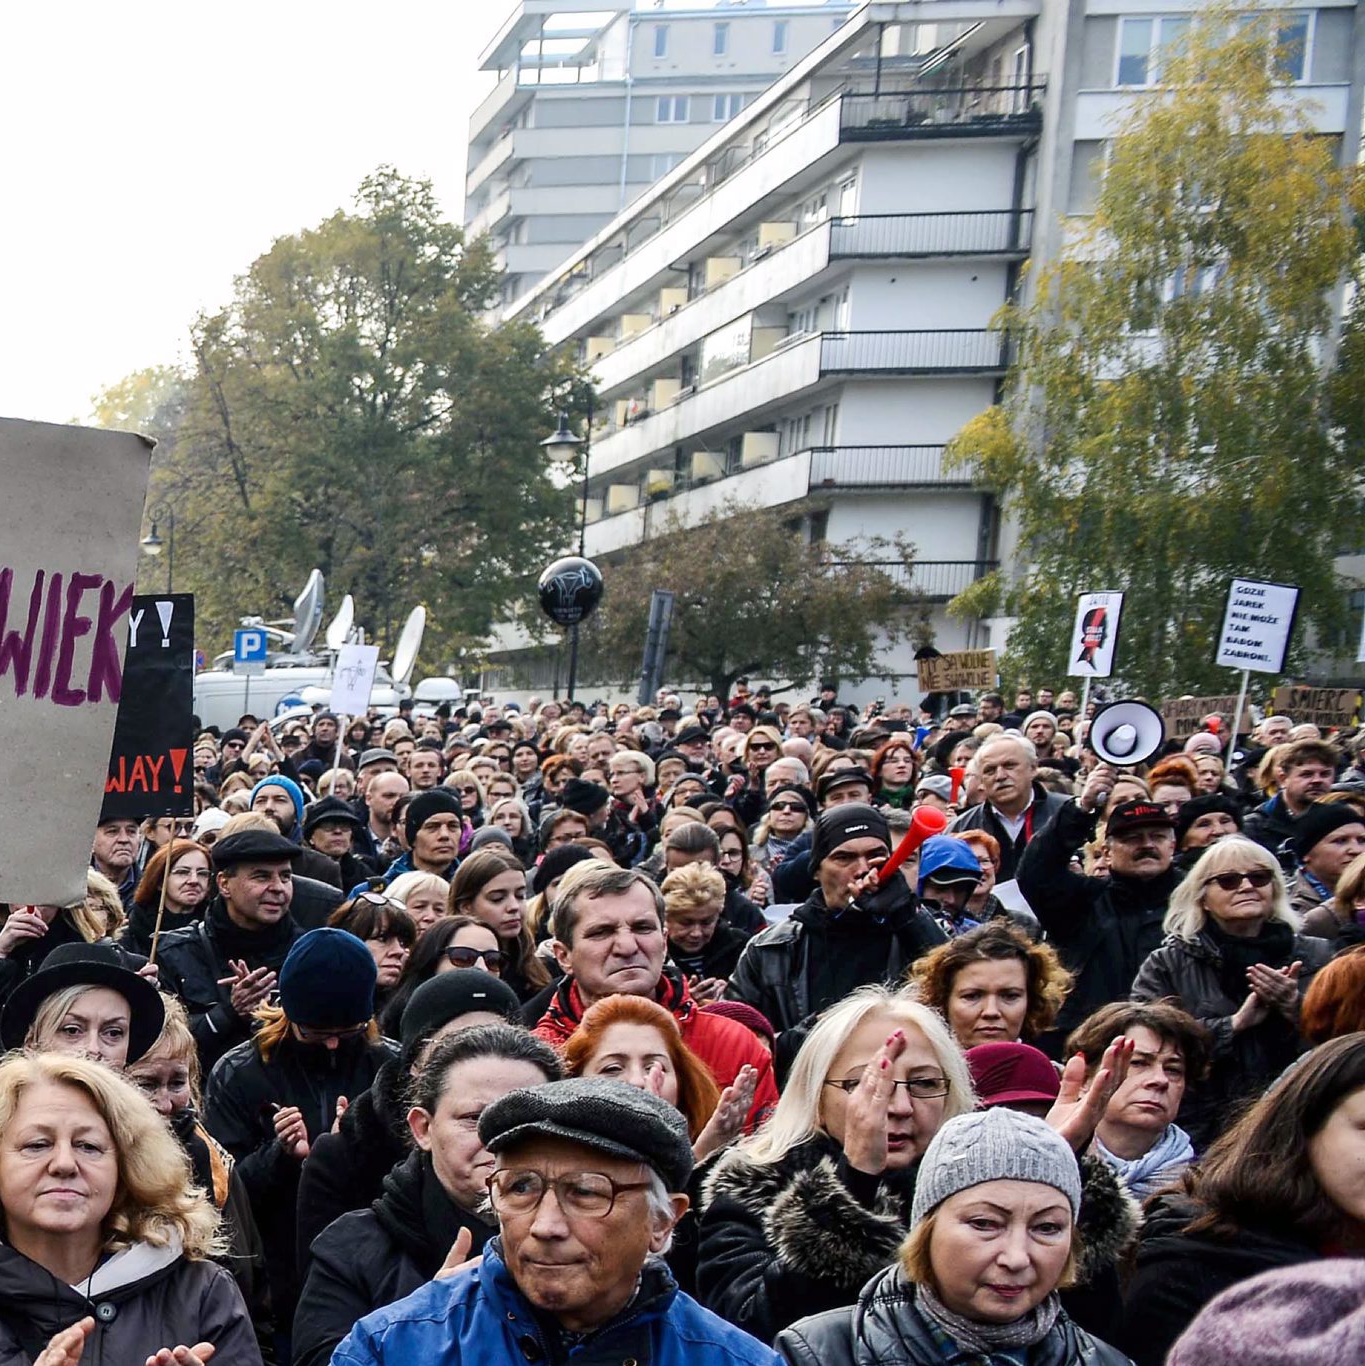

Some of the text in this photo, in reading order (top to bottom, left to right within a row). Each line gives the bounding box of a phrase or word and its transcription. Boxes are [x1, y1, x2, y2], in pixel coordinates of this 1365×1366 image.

[1233, 598, 1265, 609] JAREK
[1231, 611, 1247, 619] NIE
[1229, 623, 1251, 632] TAM
[240, 632, 261, 660] P
[1225, 636, 1263, 647] BABOM
